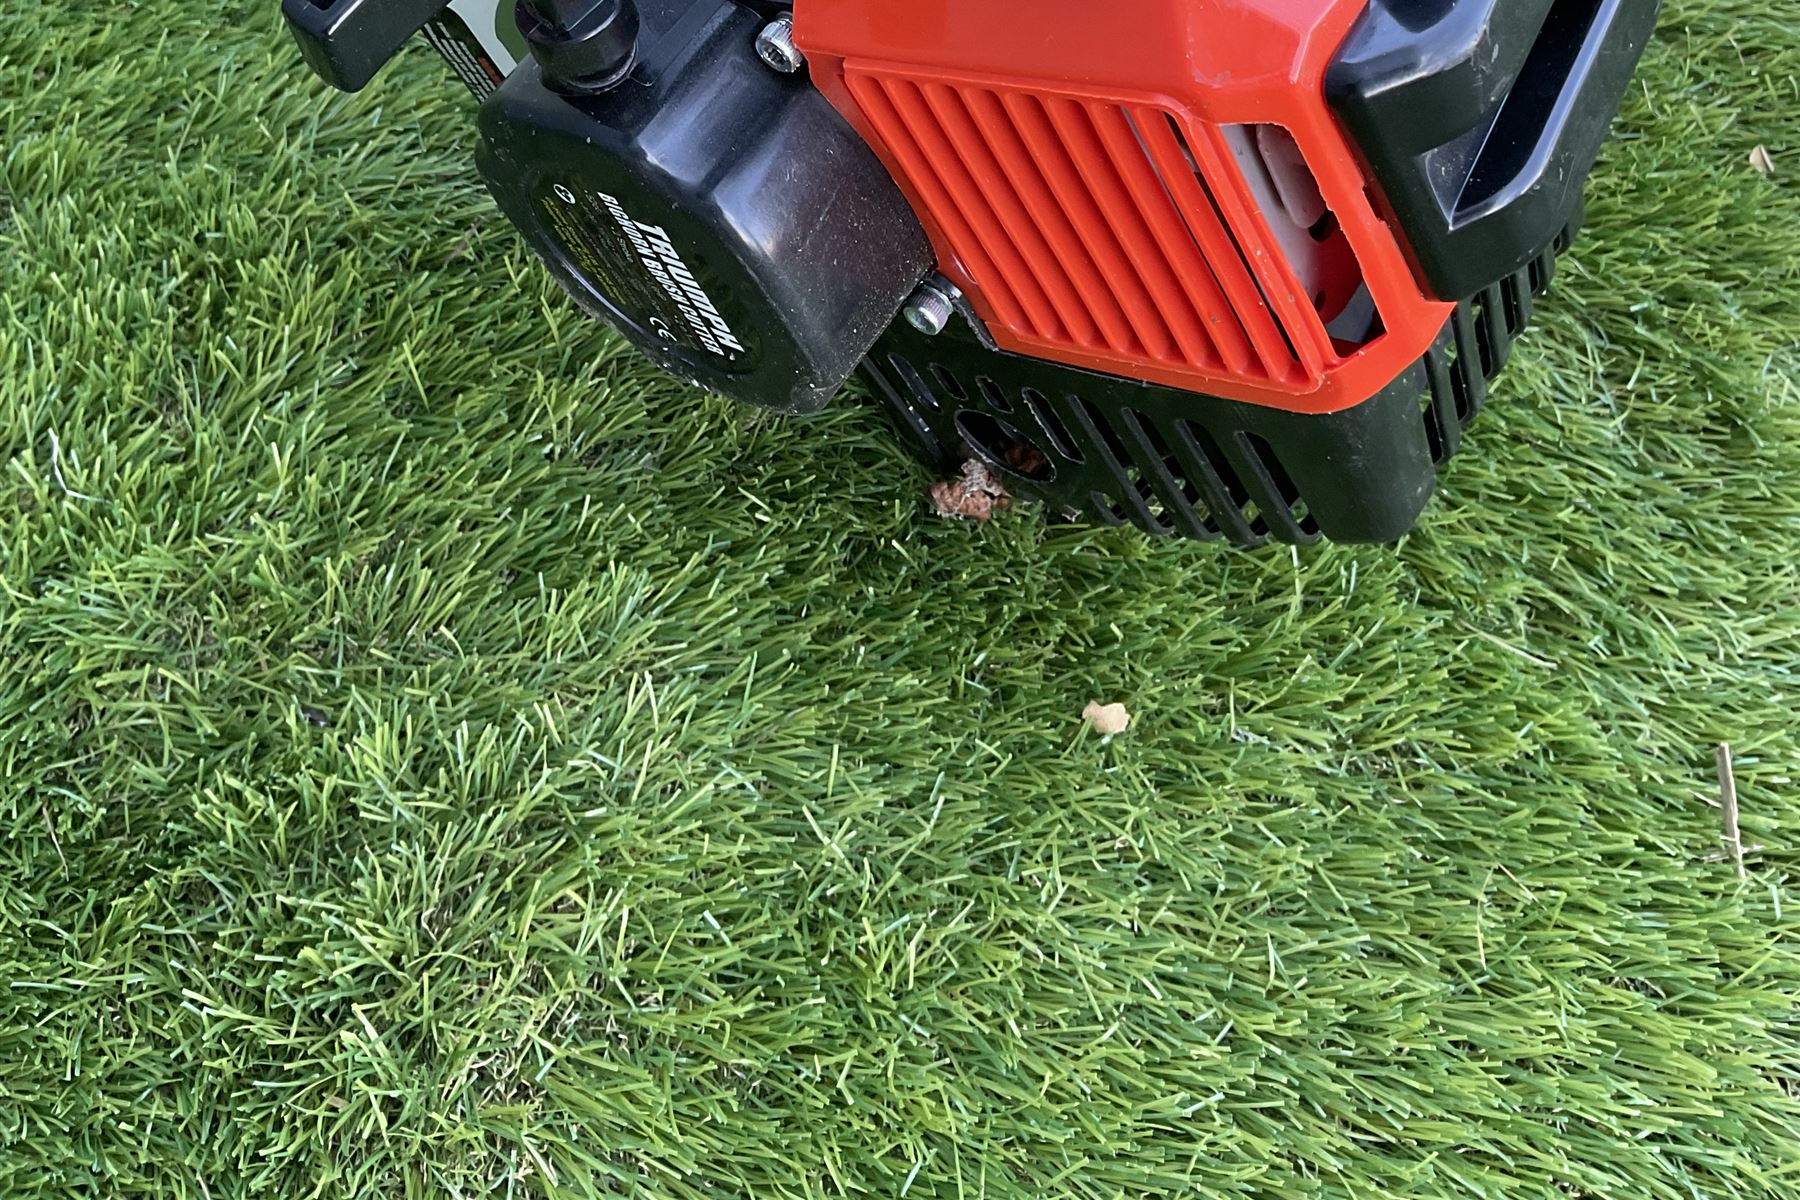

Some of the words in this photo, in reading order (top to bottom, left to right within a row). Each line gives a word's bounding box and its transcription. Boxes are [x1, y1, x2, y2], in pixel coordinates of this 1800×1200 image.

[597, 191, 657, 261] BIGHORN
[642, 257, 687, 304] BRUSH
[680, 301, 725, 356] CUTTER
[632, 220, 745, 353] TRIUMPH
